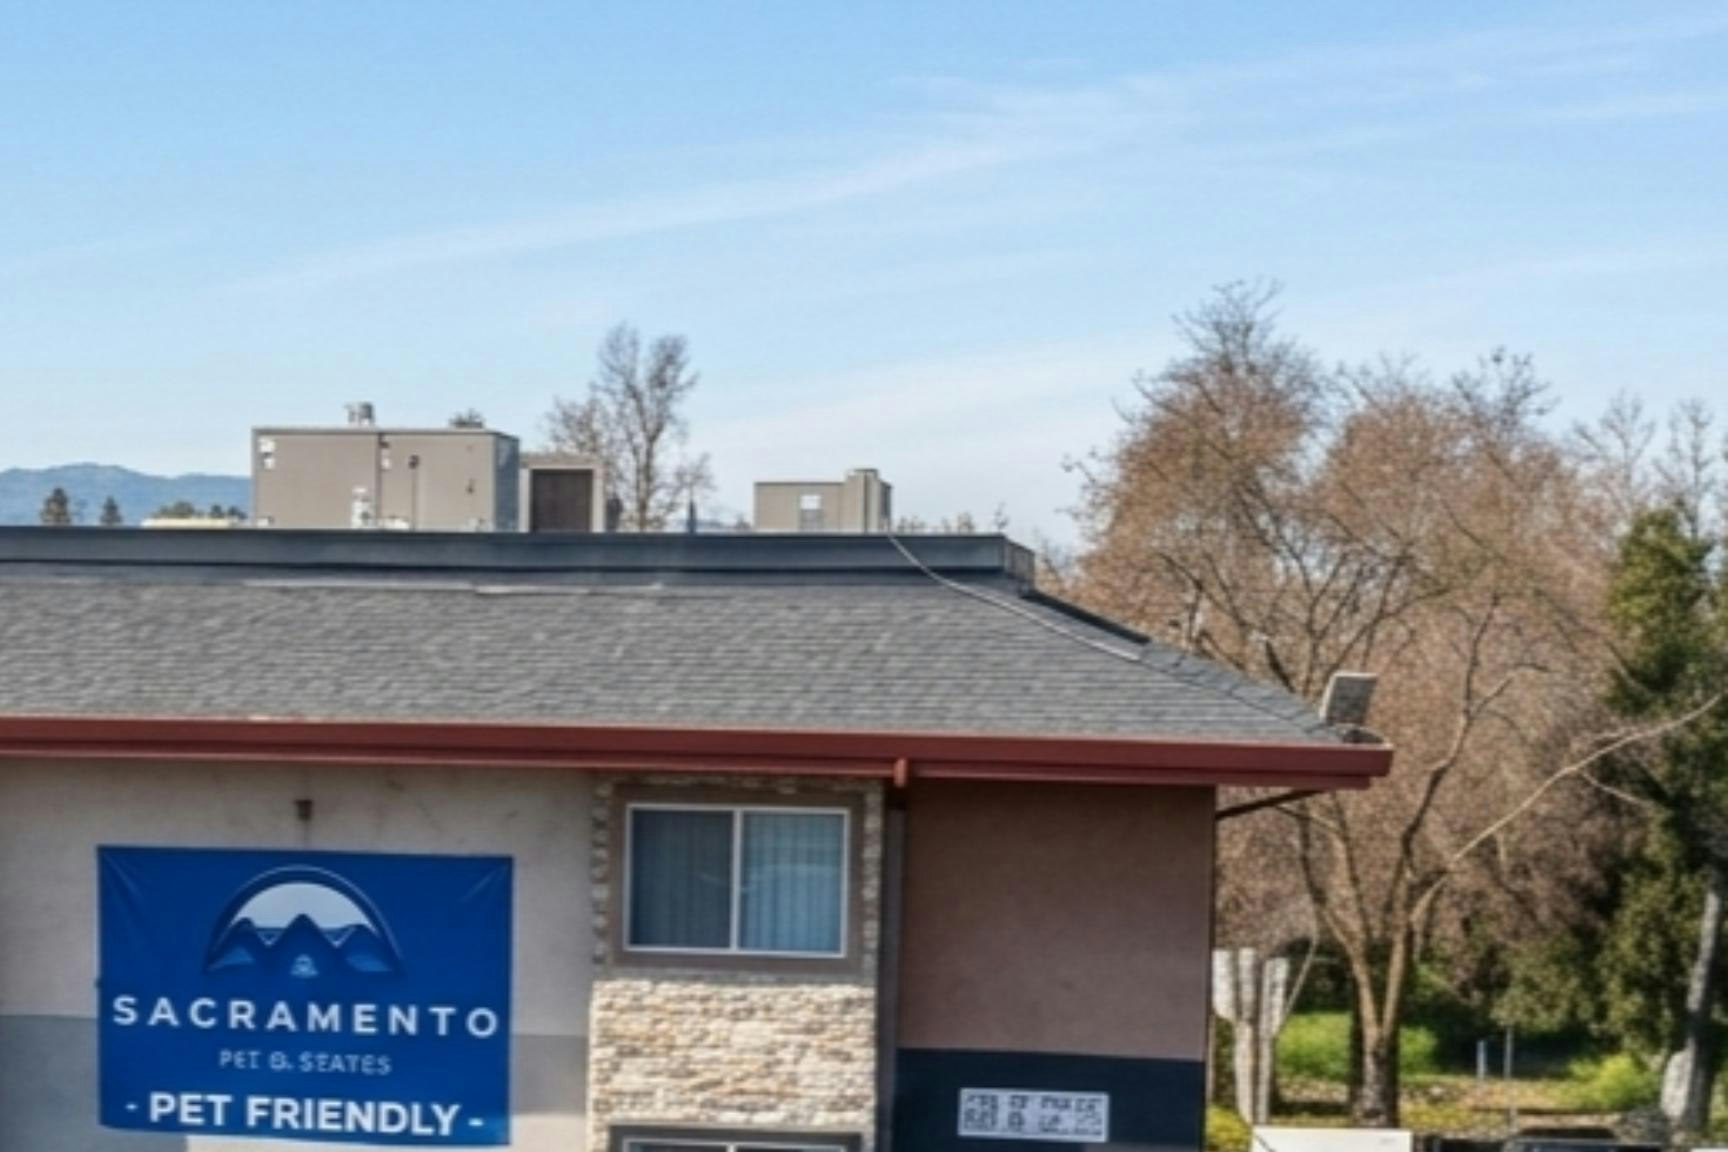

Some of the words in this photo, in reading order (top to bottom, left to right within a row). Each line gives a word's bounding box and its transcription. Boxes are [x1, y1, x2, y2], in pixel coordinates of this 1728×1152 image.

[113, 994, 498, 1039] SACRAMENTO
[219, 1049, 259, 1069] PET
[149, 1091, 233, 1127] PET
[246, 1095, 461, 1136] FRIENDLY
